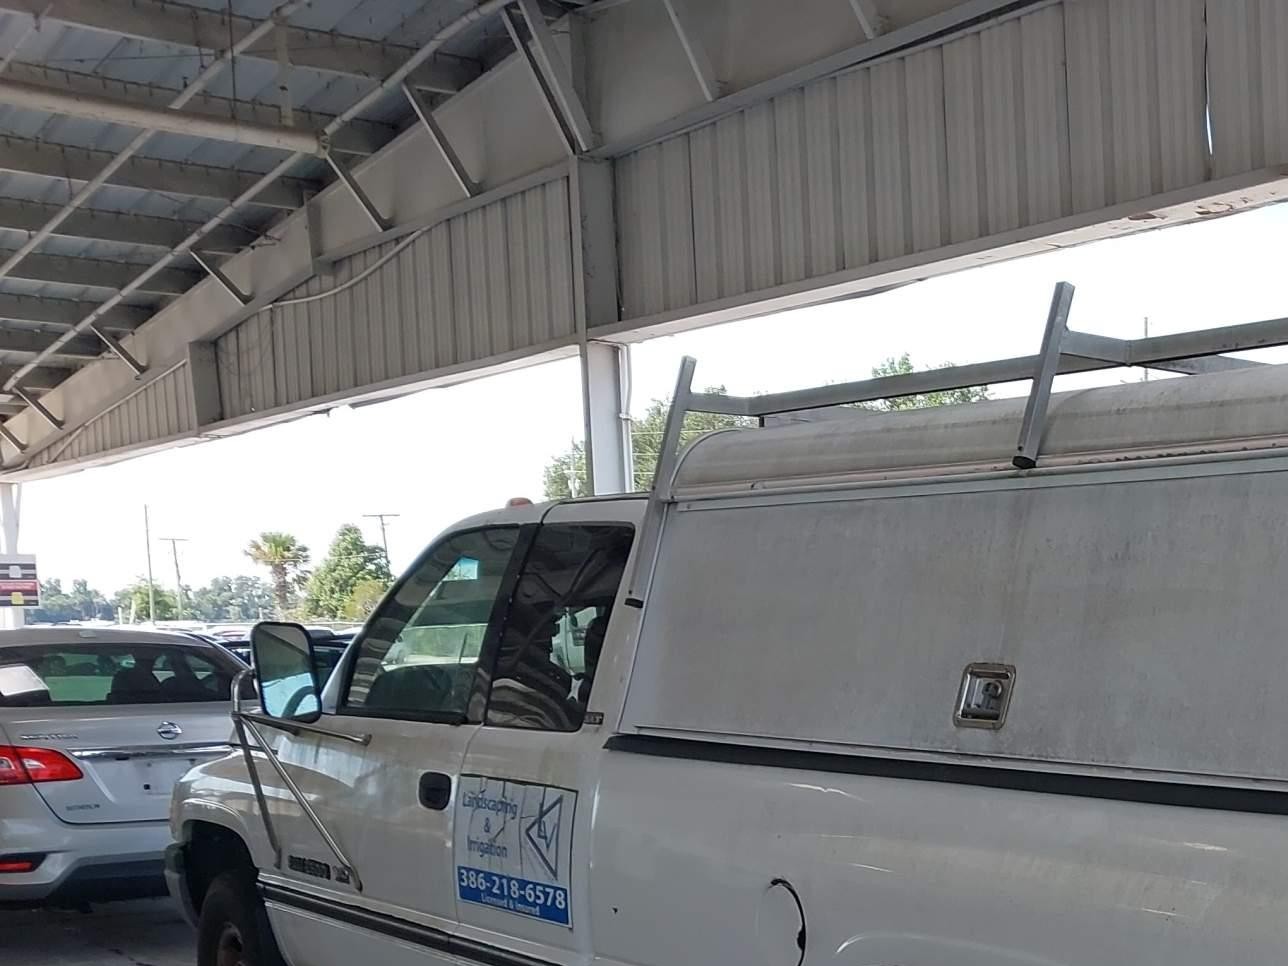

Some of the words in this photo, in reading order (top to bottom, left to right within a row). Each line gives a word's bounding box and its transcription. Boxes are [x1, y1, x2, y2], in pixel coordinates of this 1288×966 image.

[462, 791, 518, 819] Landscaping
[483, 817, 490, 833] &
[467, 835, 508, 858] Irrigation
[459, 868, 567, 910] 386-218-6578
